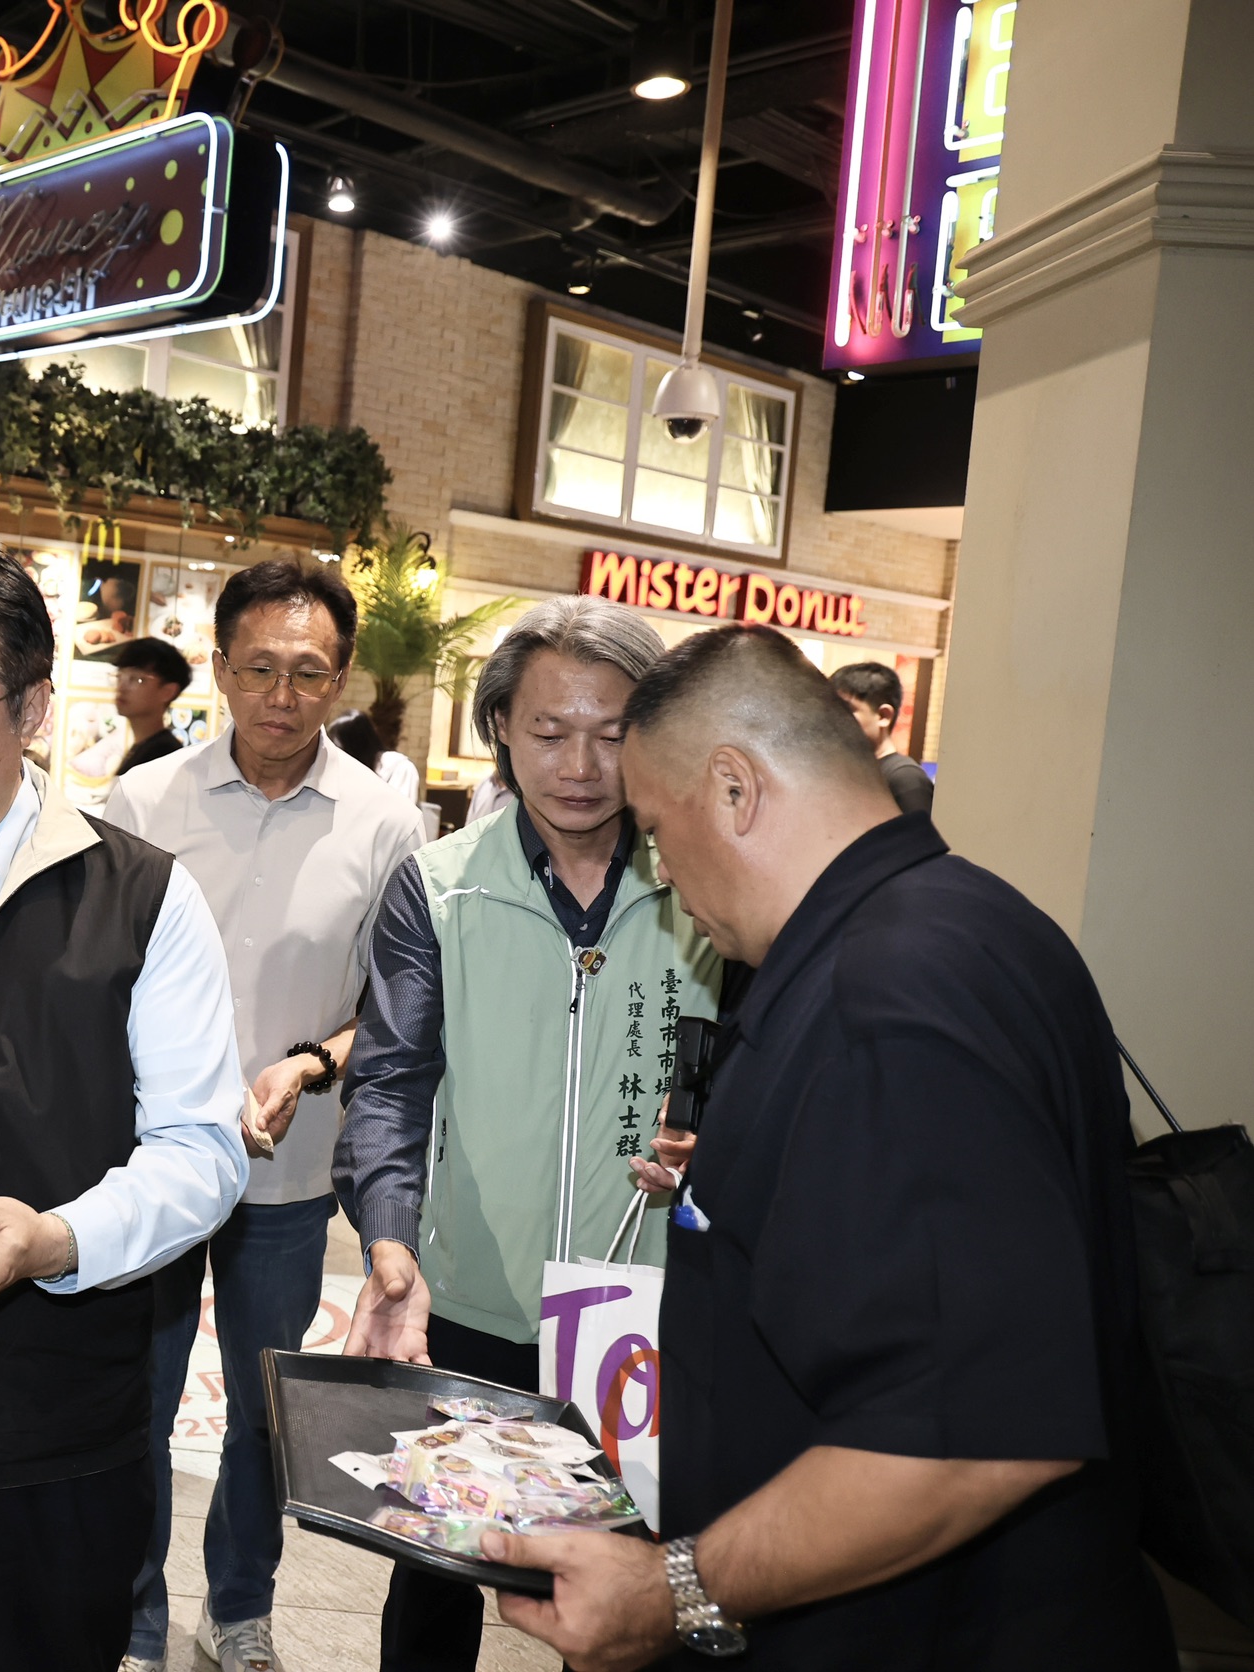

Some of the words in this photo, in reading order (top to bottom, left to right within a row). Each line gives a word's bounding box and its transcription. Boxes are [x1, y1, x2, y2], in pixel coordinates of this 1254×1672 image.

[589, 551, 740, 617] Mister
[743, 573, 868, 637] Donut
[626, 981, 646, 1058] 代理處長
[651, 968, 682, 1127] 臺南市市場
[615, 1073, 647, 1157] 林士群
